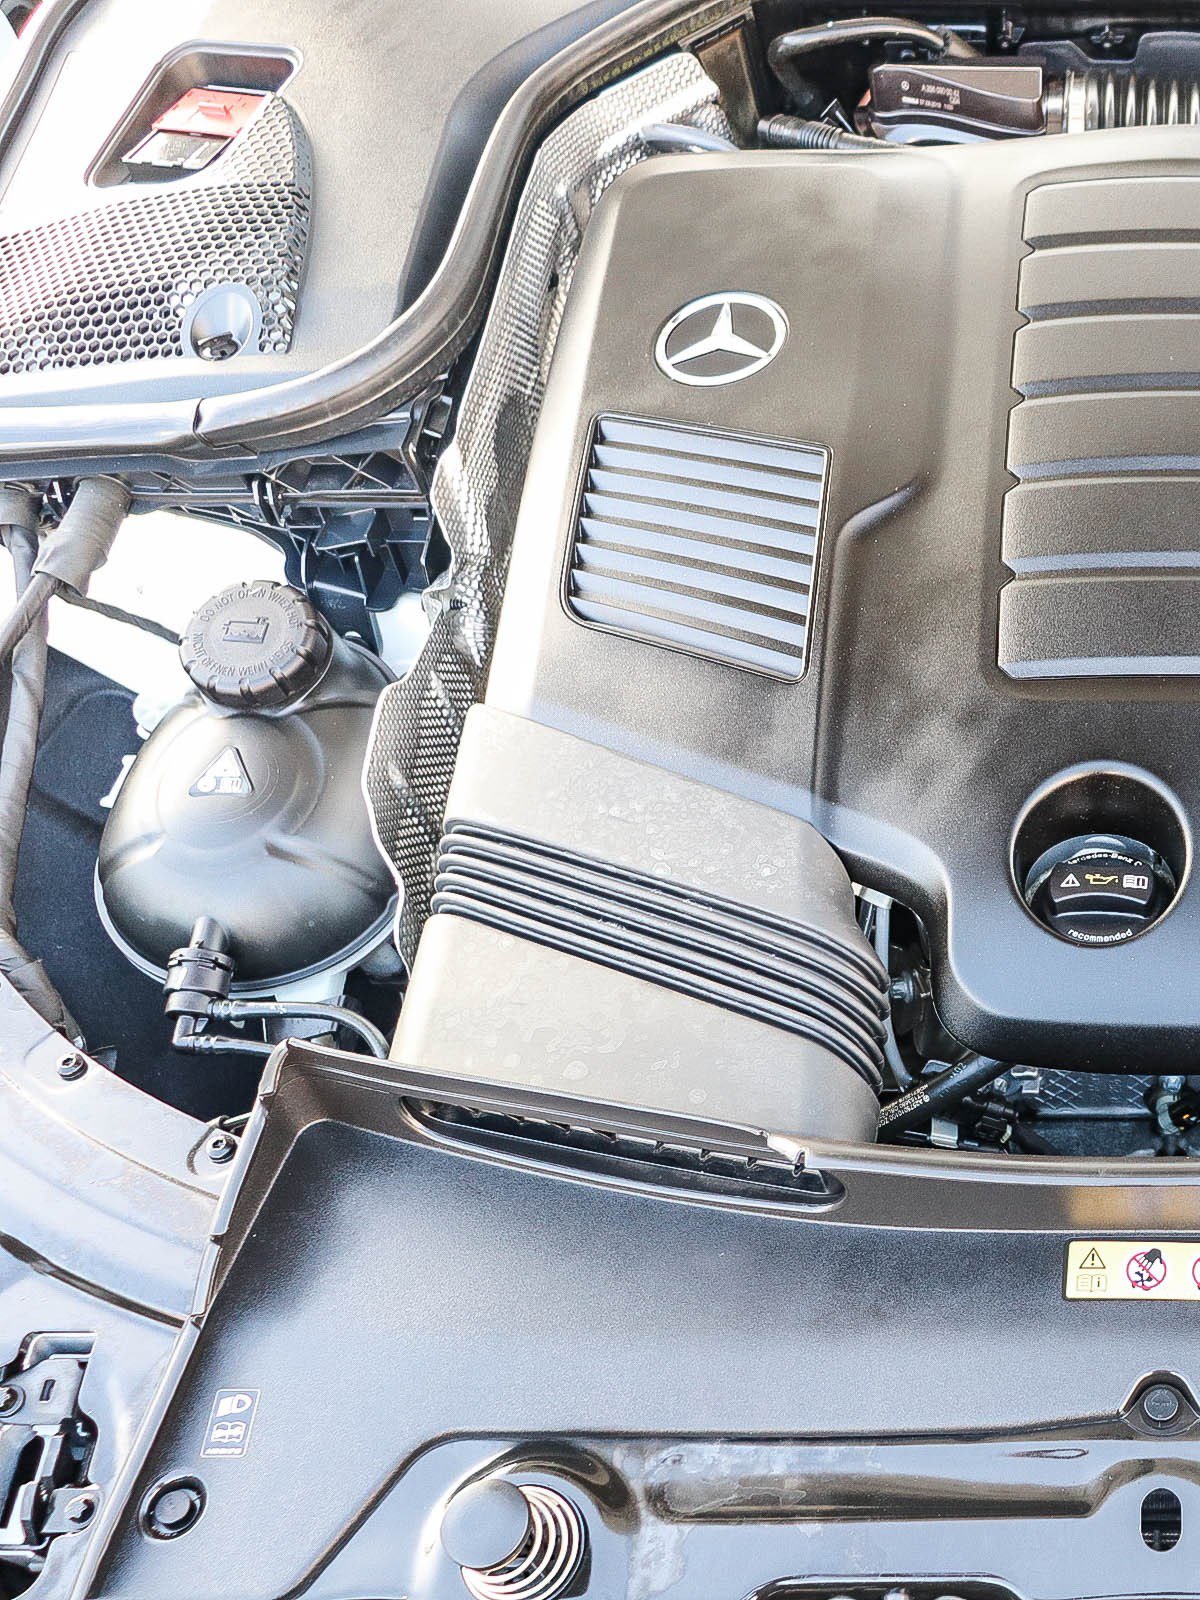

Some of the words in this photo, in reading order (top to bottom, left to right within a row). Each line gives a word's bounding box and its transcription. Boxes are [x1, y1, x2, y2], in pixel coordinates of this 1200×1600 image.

[200, 609, 215, 623] DO
[216, 594, 234, 610] NOT
[268, 591, 294, 614] WHEN
[1068, 928, 1133, 943] recommended
